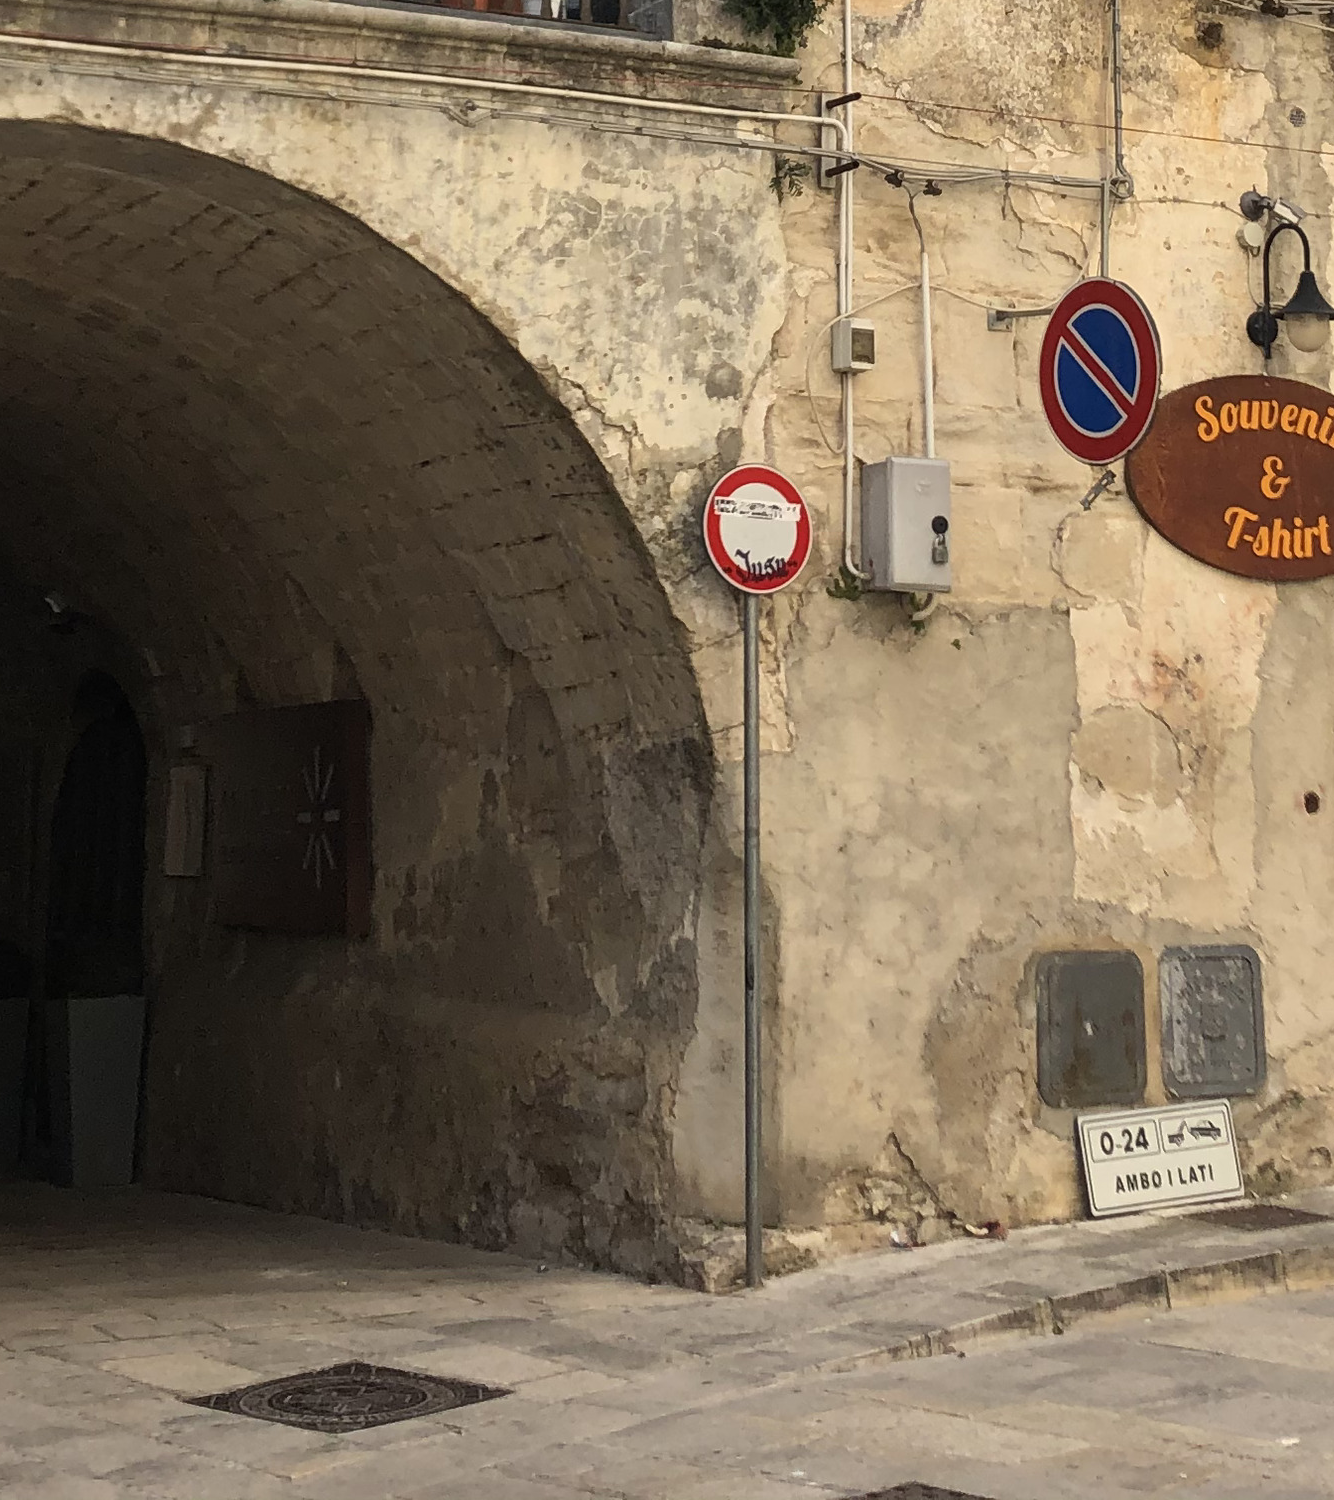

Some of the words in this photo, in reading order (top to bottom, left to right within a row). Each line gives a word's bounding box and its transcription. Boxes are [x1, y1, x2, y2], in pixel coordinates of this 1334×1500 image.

[1260, 455, 1292, 499] &
[1223, 506, 1332, 559] T-shirt
[1115, 1169, 1162, 1194] AMBO
[1167, 1169, 1174, 1187] I
[1178, 1163, 1215, 1185] LATI
